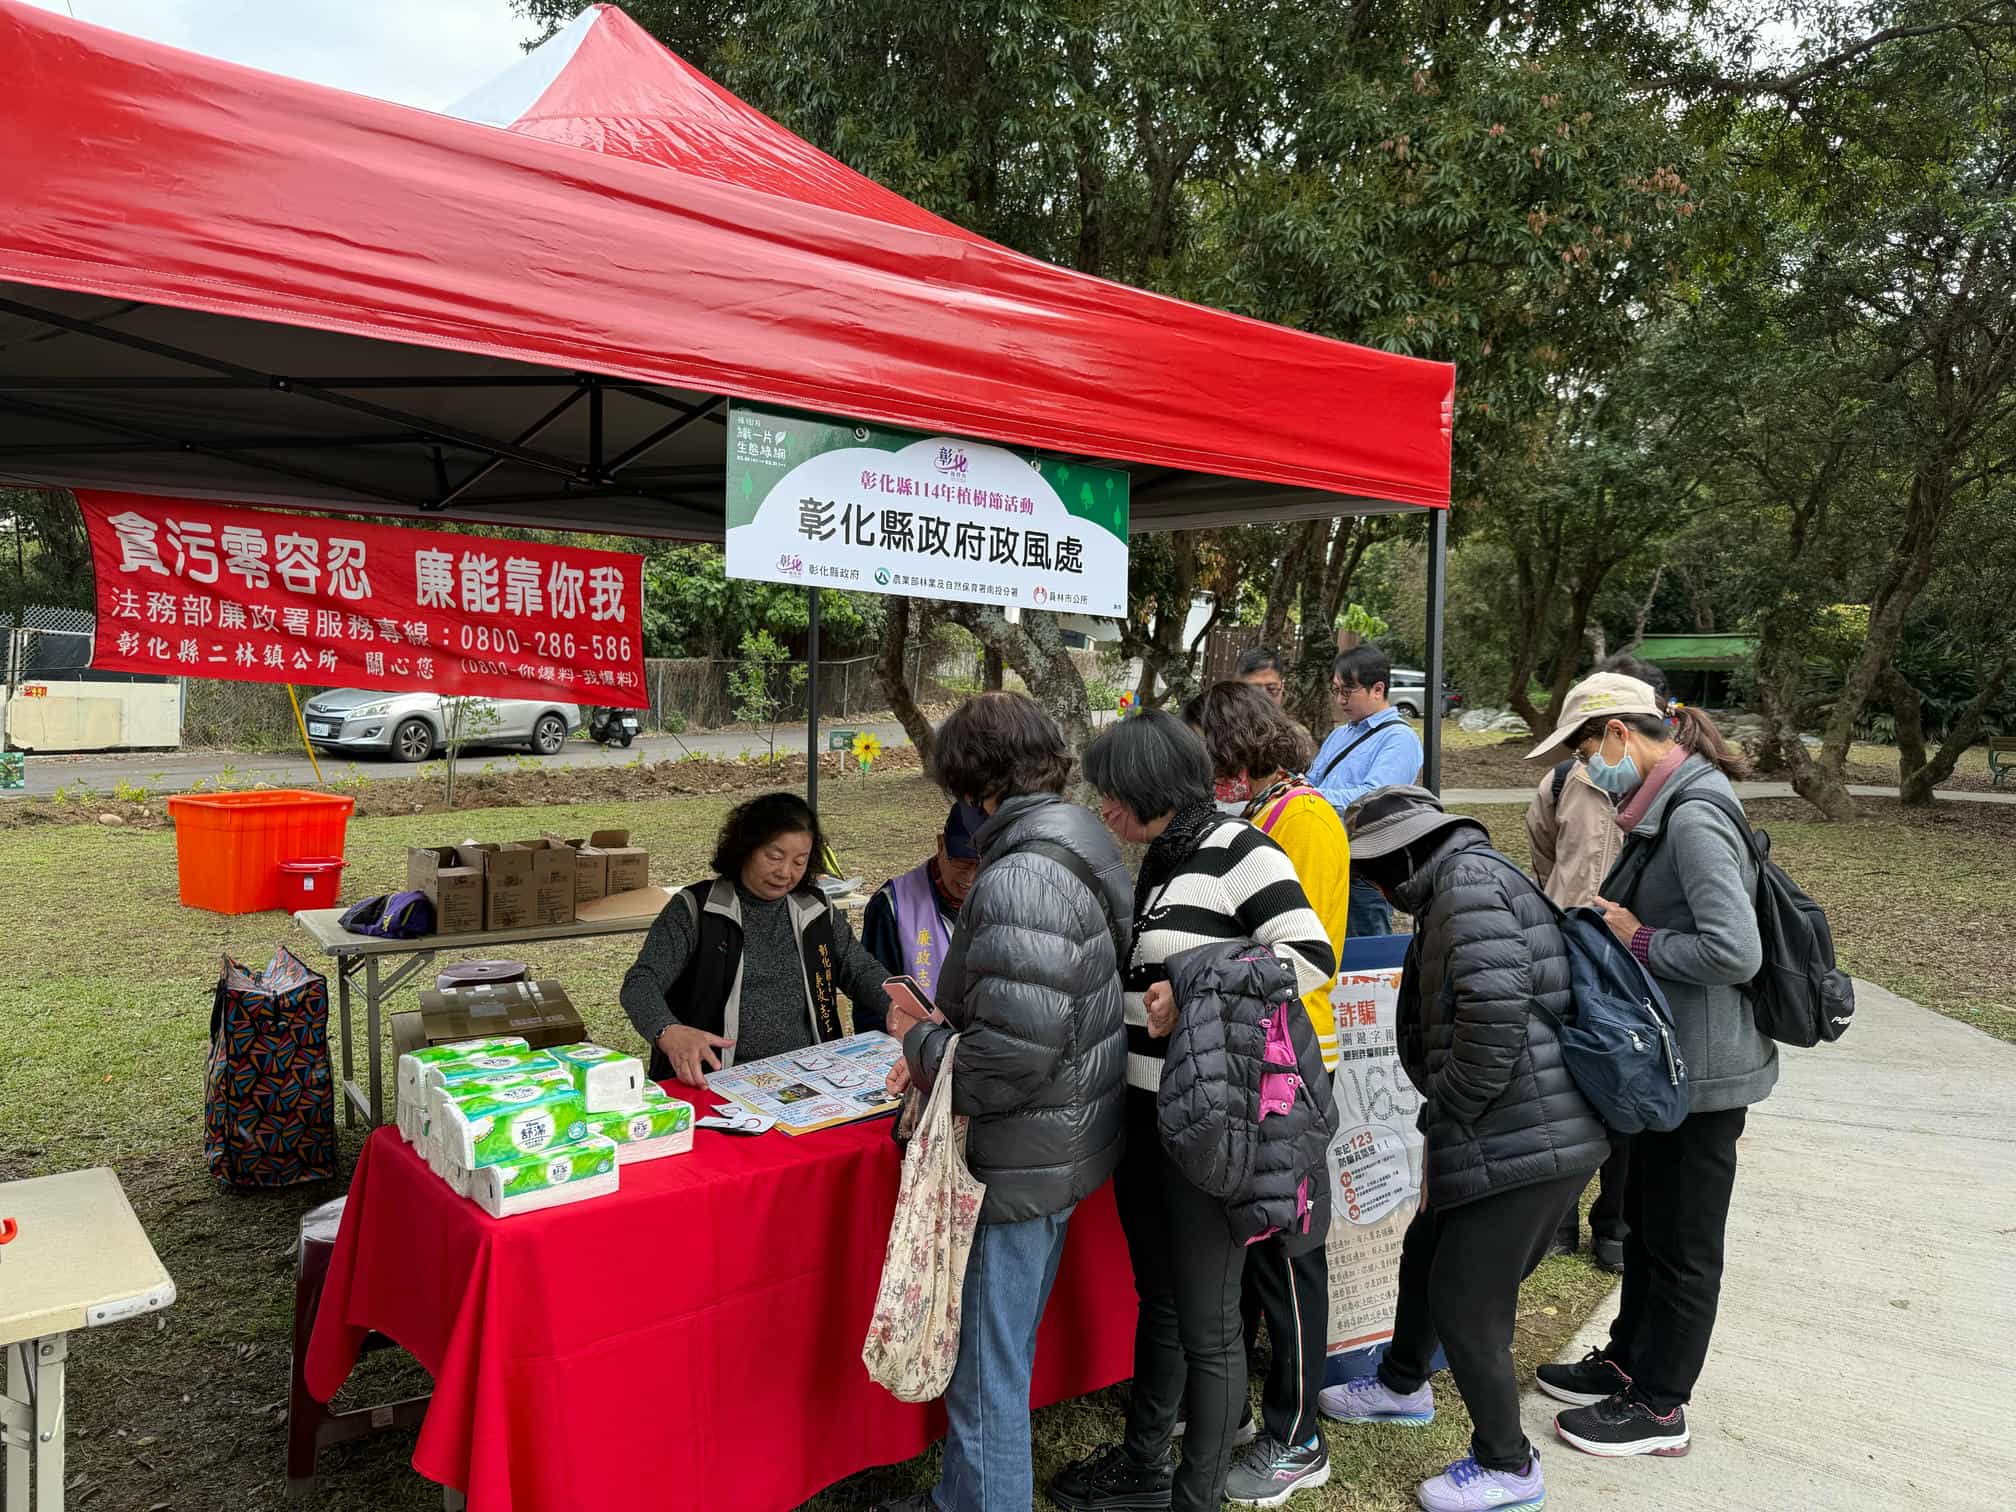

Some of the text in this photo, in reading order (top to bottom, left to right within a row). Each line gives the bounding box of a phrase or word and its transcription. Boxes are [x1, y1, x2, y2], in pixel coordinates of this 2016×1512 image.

[860, 470, 1034, 516] 彰化縣114年植樹節活動
[798, 497, 1084, 574] 彰化縣政府政風處
[107, 511, 625, 623] 貪污零容忍 廉能靠你我
[808, 564, 860, 581] 彰化縣政府
[116, 630, 435, 680] 彰化縣二林鎮公所 關心您
[1338, 1000, 1376, 1028] 詐騙
